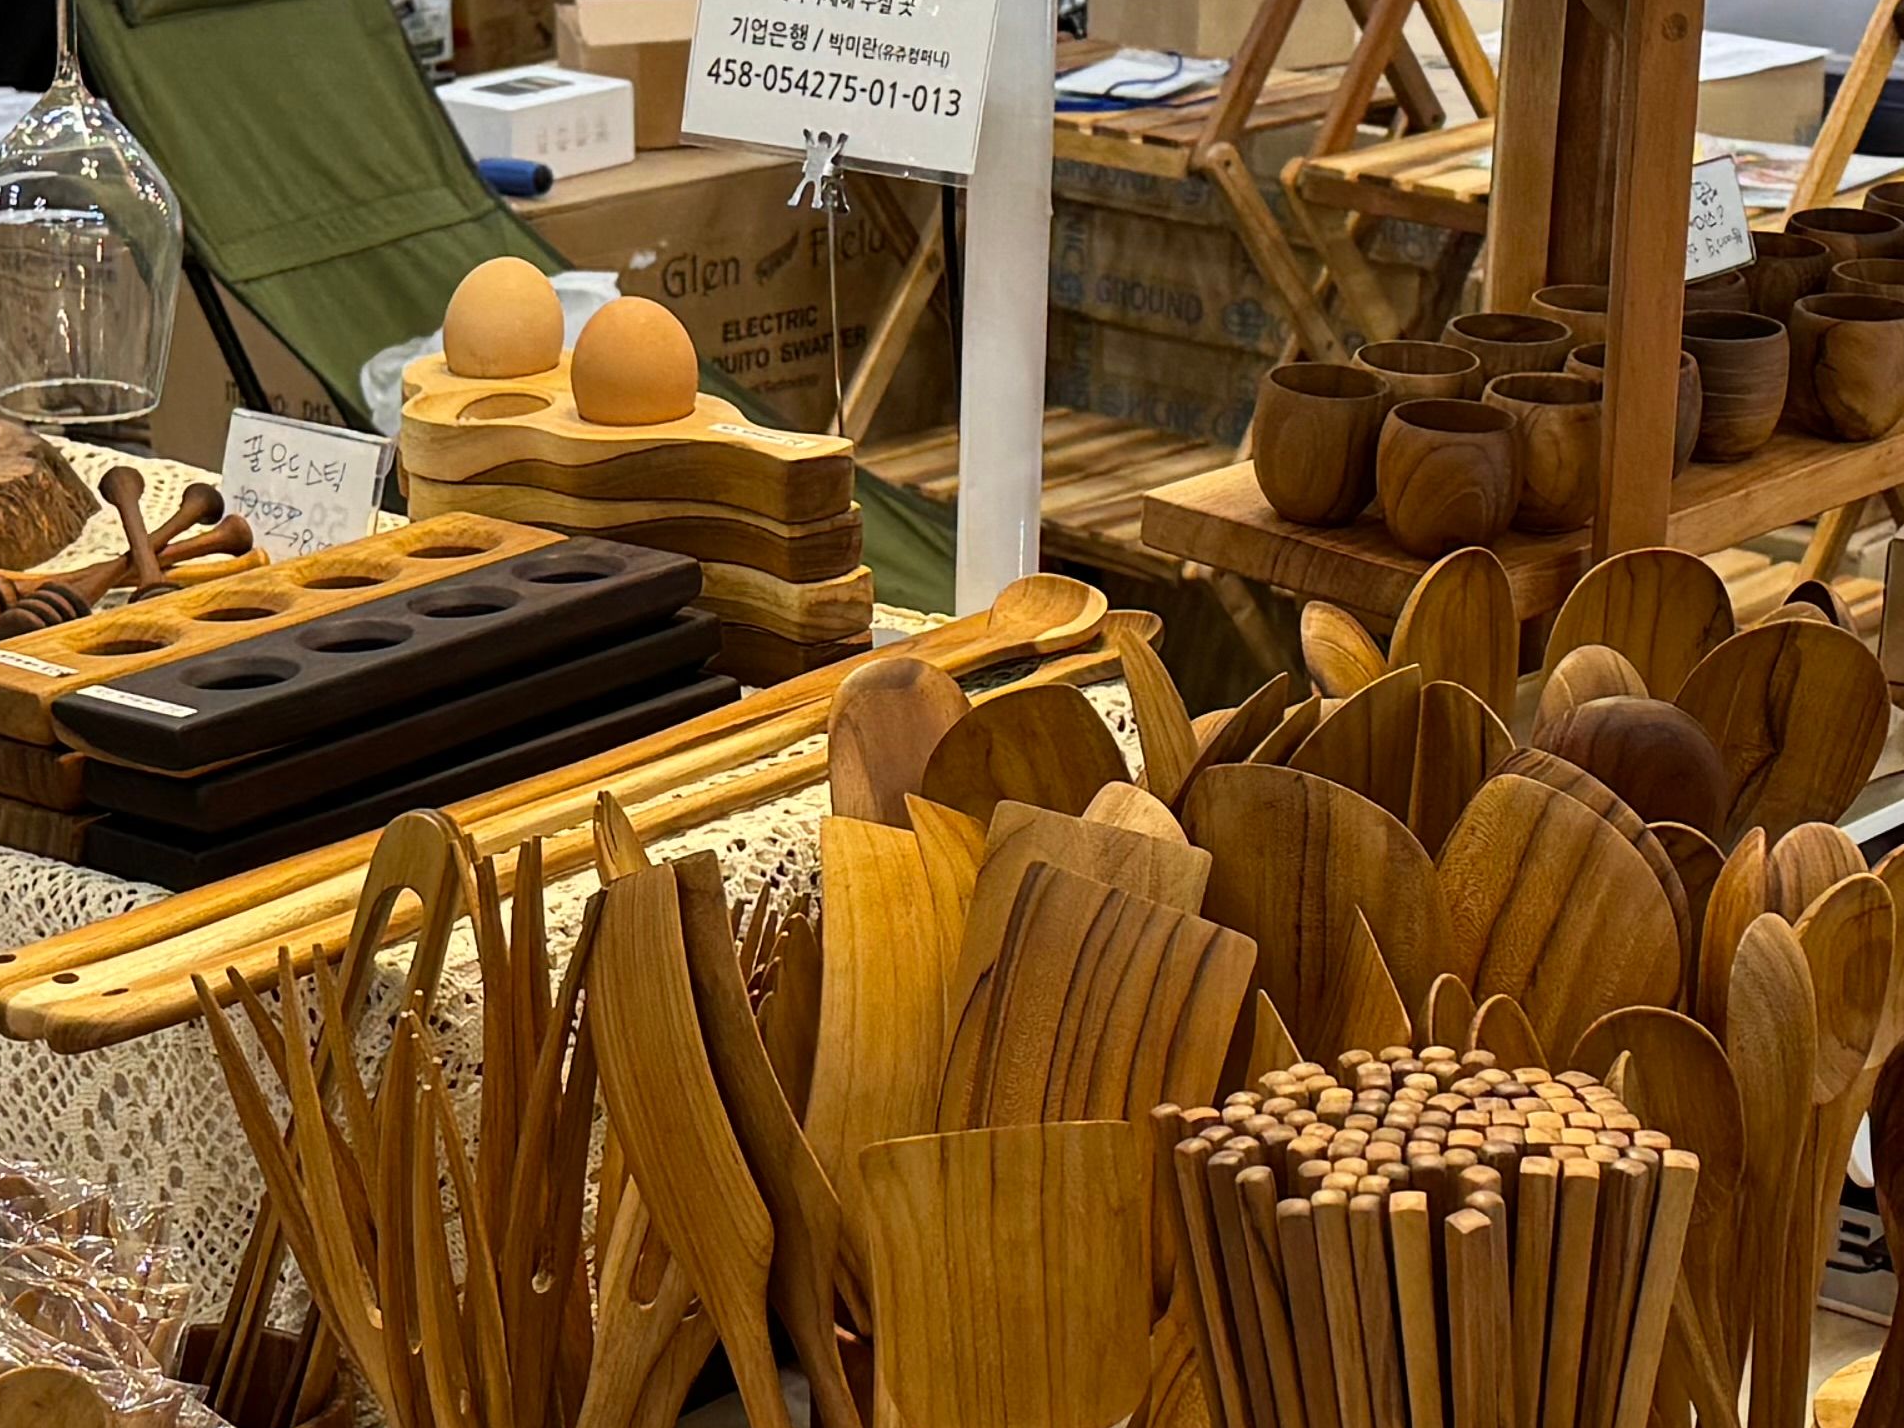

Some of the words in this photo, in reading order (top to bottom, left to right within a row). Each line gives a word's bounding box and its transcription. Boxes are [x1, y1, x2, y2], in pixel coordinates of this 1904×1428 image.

[730, 16, 810, 52] 기업은행
[707, 56, 963, 117] 458-054275-01-013
[721, 305, 819, 344] ELECTRIC
